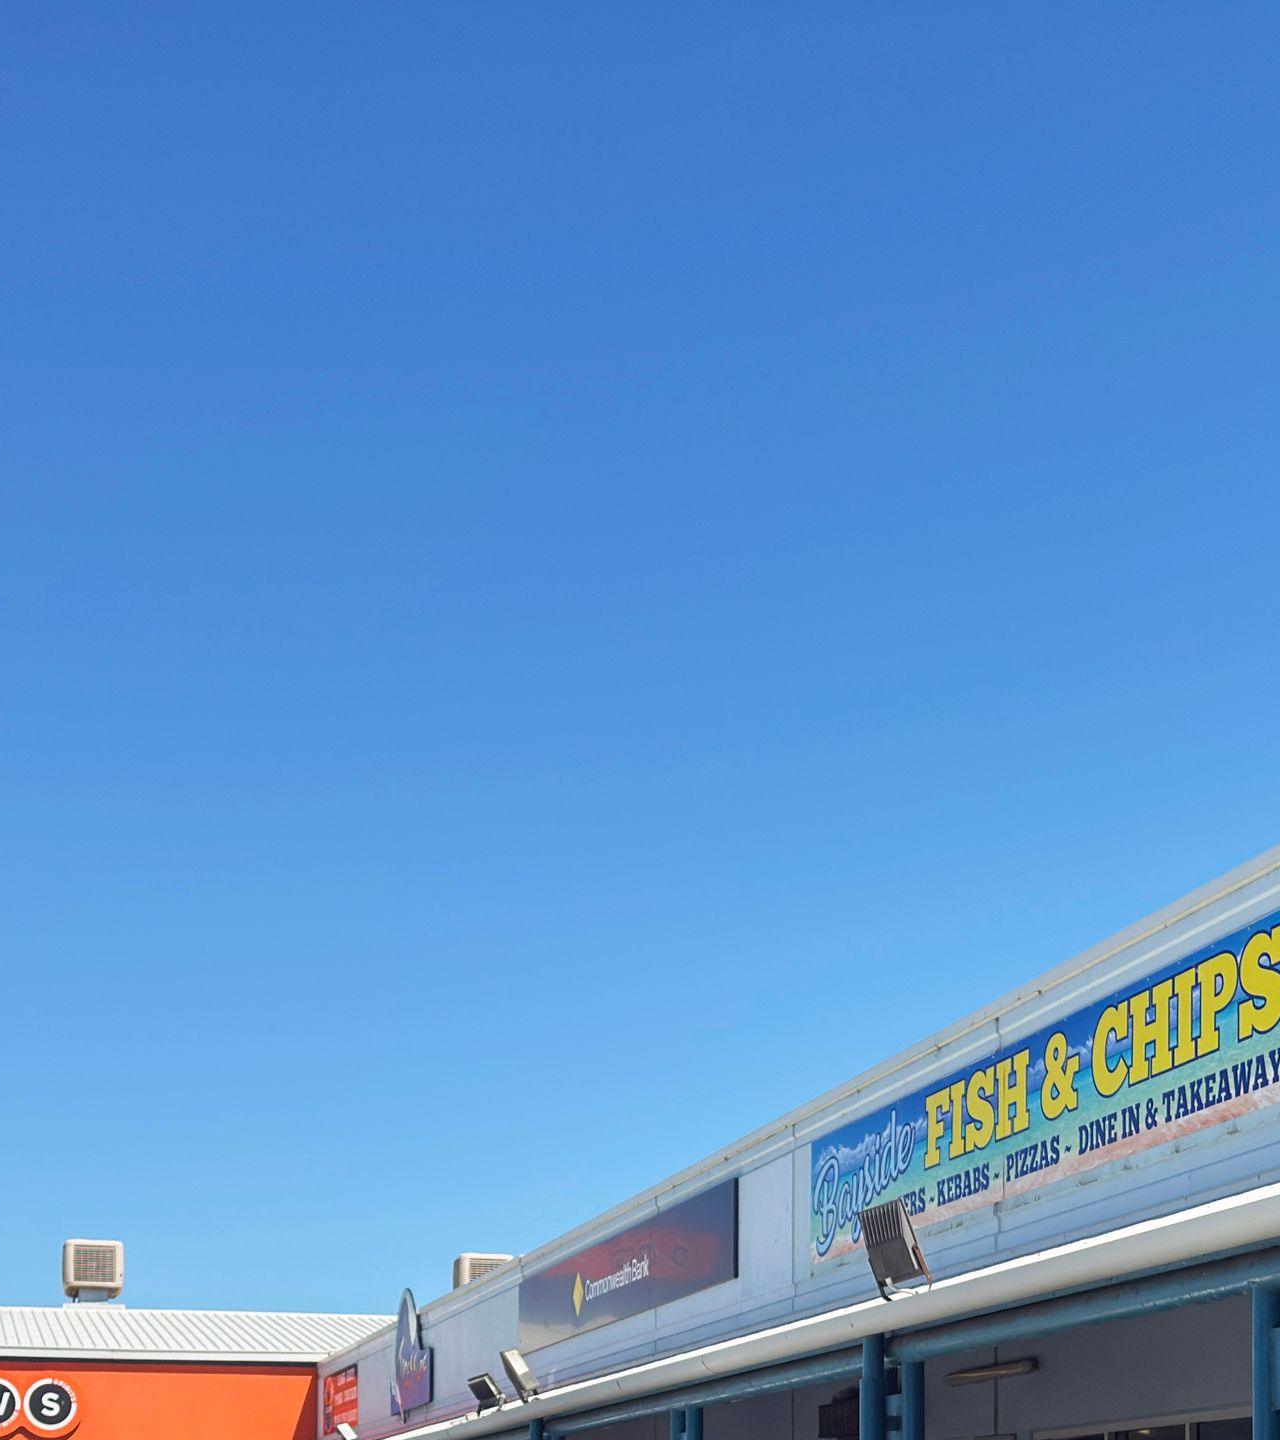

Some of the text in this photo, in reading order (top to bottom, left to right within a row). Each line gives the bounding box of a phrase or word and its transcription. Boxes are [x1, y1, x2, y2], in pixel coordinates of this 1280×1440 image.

[813, 1108, 916, 1256] Bayside
[923, 1048, 1030, 1170] FISH
[1041, 1031, 1080, 1121] &
[937, 1162, 990, 1207] KEBABS
[1006, 1135, 1060, 1182] PIZZAS
[1078, 1117, 1117, 1155] DINE
[1121, 1103, 1140, 1139] IN
[1145, 1097, 1157, 1131] &
